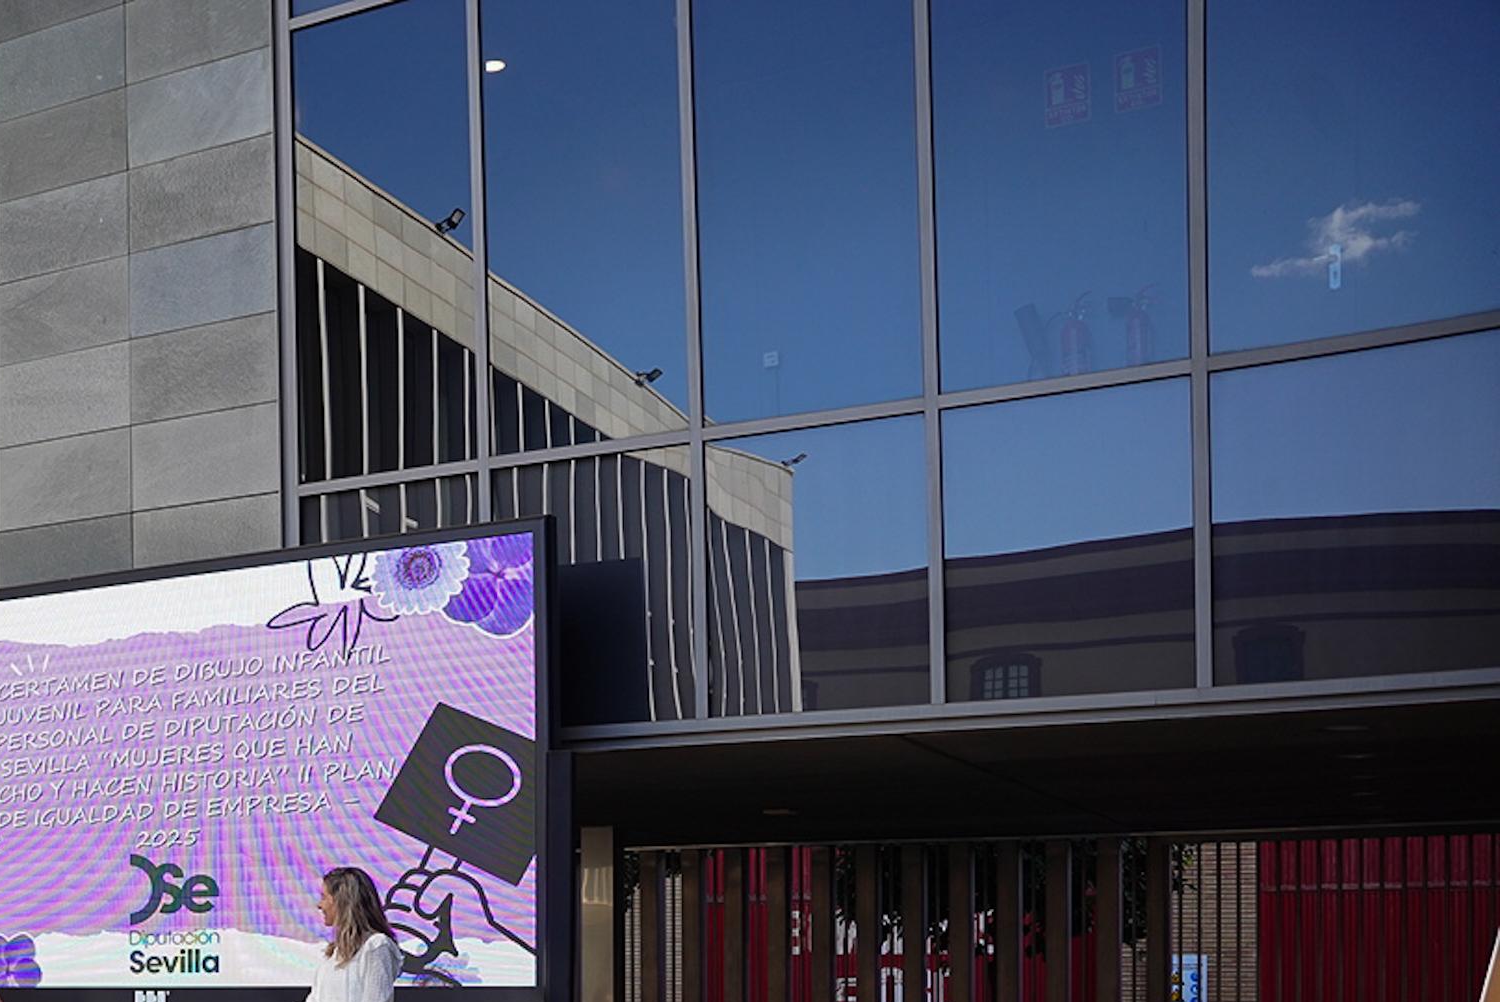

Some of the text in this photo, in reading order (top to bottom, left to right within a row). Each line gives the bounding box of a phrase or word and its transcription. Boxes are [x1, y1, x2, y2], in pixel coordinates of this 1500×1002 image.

[132, 665, 166, 687] DE
[174, 656, 264, 682] DIBUJO
[273, 644, 391, 673] INFANTIL
[96, 694, 162, 718] PARA
[171, 678, 322, 711] FAMILIARES
[332, 673, 385, 696] DEL
[123, 721, 156, 741] DE
[164, 705, 317, 737] DIPUTACIÓN
[328, 702, 365, 724] DE
[1, 755, 91, 778] SEVILLA
[233, 737, 286, 762] QUE
[295, 731, 353, 756] HAN
[51, 779, 65, 800] Y
[71, 775, 151, 800] HACEN
[298, 765, 312, 784] II
[324, 758, 397, 783] PLAN
[35, 803, 154, 828] IGUALDAD
[164, 800, 197, 819] DE
[206, 792, 332, 818] EMPRESA
[136, 827, 200, 849] 2025
[129, 928, 221, 949] Diputación
[130, 949, 219, 974] Sevilla
